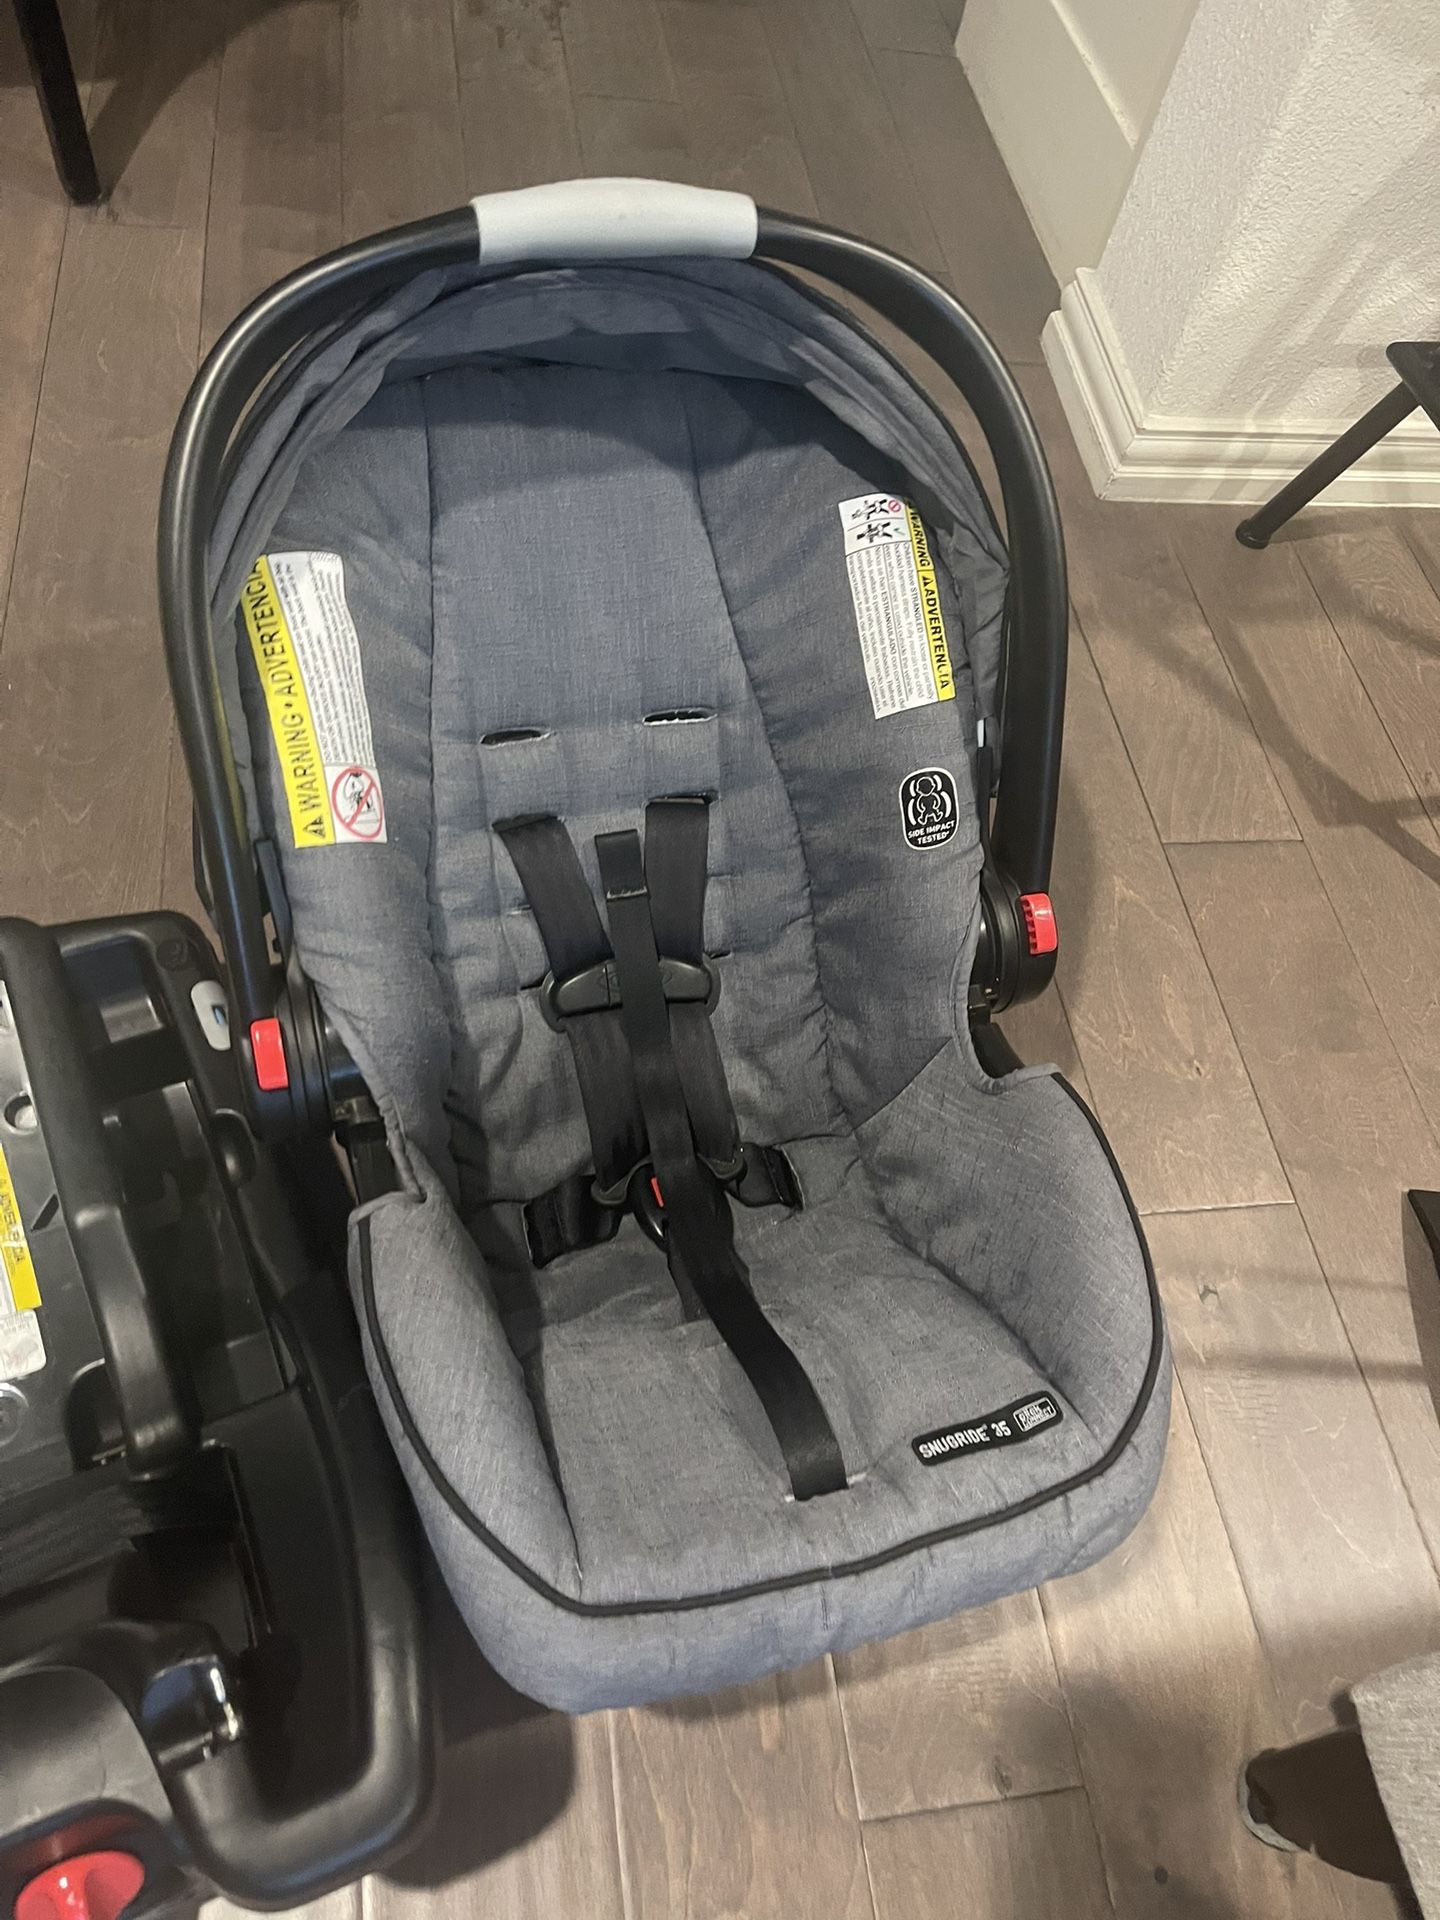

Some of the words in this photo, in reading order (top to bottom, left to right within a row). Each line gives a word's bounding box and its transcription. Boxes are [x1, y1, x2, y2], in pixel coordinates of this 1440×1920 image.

[910, 511, 930, 566] WARNING
[880, 591, 896, 655] ESTRANGULADO
[910, 586, 923, 633] STRANGLED
[924, 588, 949, 688] ADVERTENCIA
[281, 713, 317, 812] WARNING
[908, 828, 925, 839] SIDE
[926, 820, 955, 833] IMPACT
[991, 1420, 1011, 1438] 35
